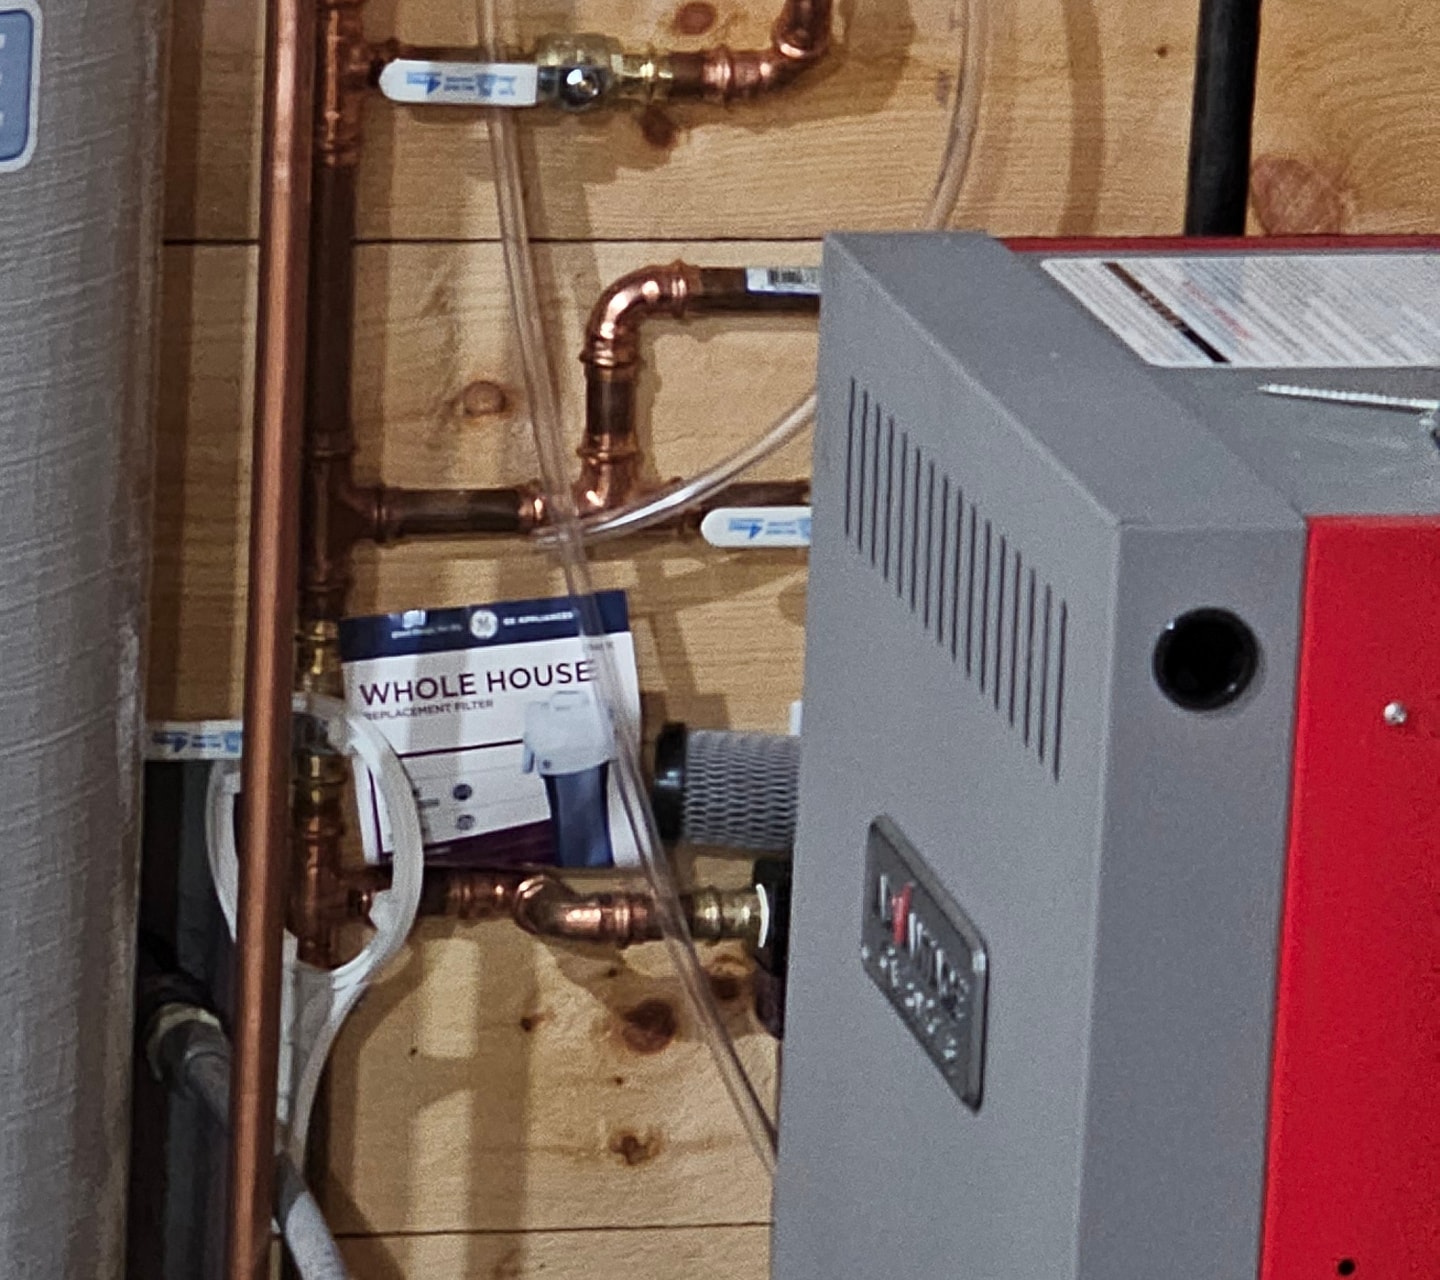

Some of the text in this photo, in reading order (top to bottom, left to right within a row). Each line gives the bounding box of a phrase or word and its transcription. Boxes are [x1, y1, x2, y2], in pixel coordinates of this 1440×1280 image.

[360, 659, 596, 706] WHOLE HOUSE
[454, 698, 494, 712] FILTER
